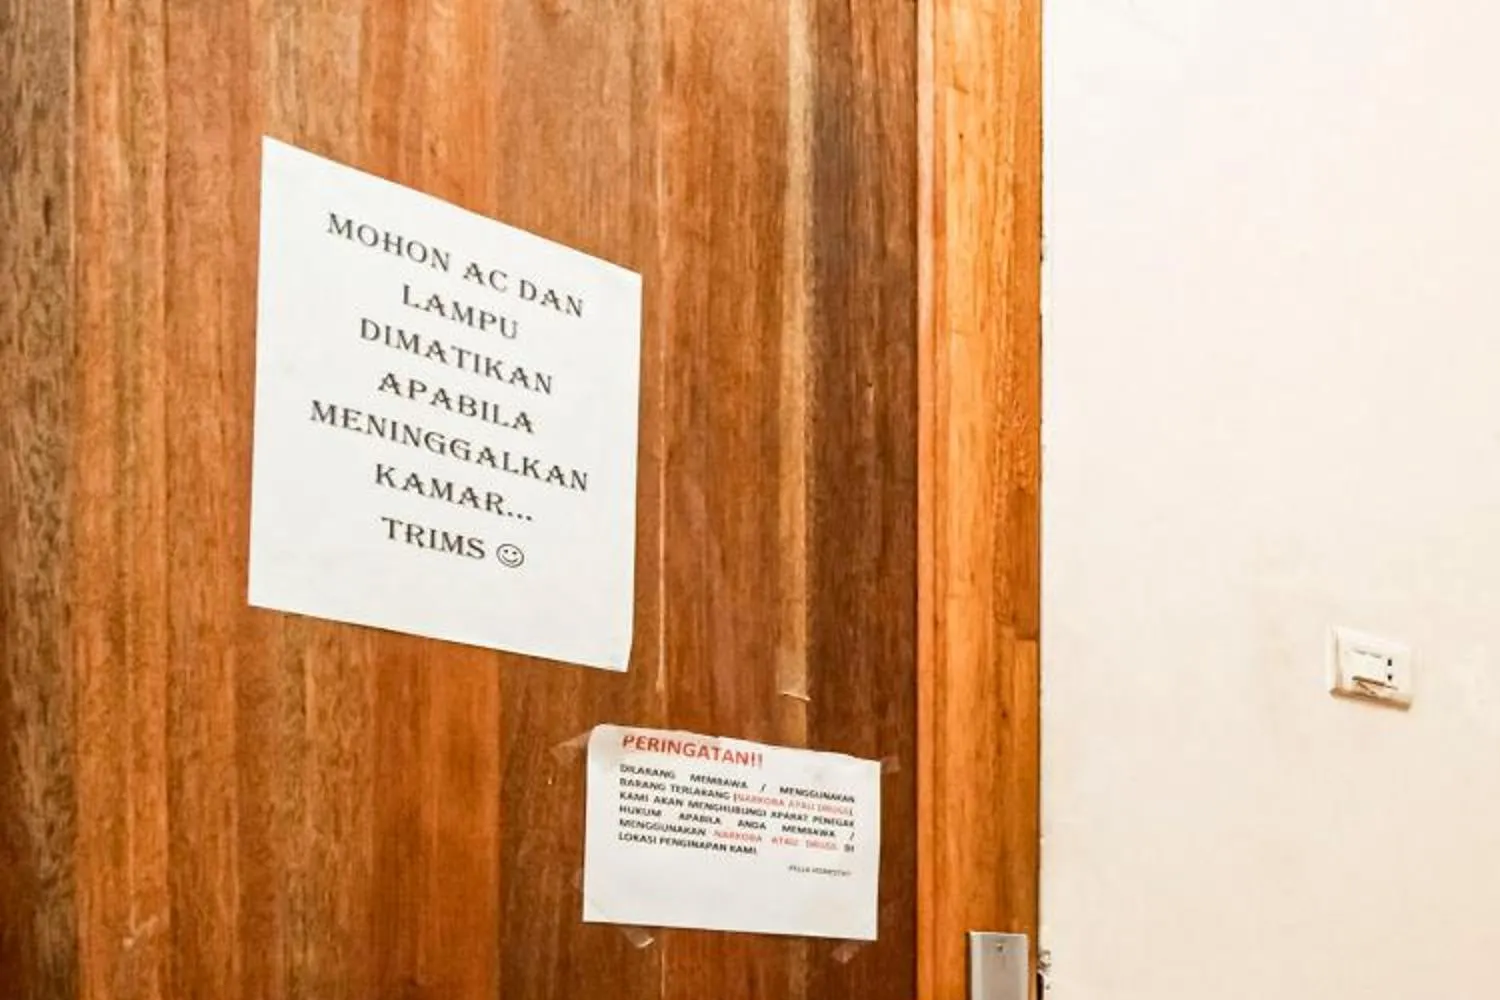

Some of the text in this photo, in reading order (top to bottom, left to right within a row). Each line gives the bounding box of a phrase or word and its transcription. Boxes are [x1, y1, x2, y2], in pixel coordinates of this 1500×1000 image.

[327, 212, 584, 318] MOHON AC DAN
[402, 285, 519, 340] LAMPU
[360, 317, 553, 395] DIMATIKAN
[378, 372, 534, 434] APABILA
[309, 400, 589, 493] MENINGGALKAN
[374, 463, 533, 522] KAMAR...
[382, 516, 486, 561] TRIMS
[623, 735, 763, 769] PERINGATAN!!
[620, 764, 675, 779] DILARANG
[690, 773, 748, 789] MEMBAWA
[779, 786, 855, 803] MENGGUNAKAN
[620, 777, 666, 791] BARANG
[670, 784, 730, 800] TERLARANG
[620, 791, 649, 803] KAMI
[653, 795, 683, 807] AKAN
[687, 800, 767, 819] MENGHUBUNGI
[770, 811, 808, 822] APARAT
[620, 805, 661, 817] HUKUM
[679, 812, 721, 826] APABILA
[619, 831, 657, 845] LOKASI
[659, 837, 727, 853] PENGINAPAN
[620, 818, 706, 838] MENGGUNAKAN
